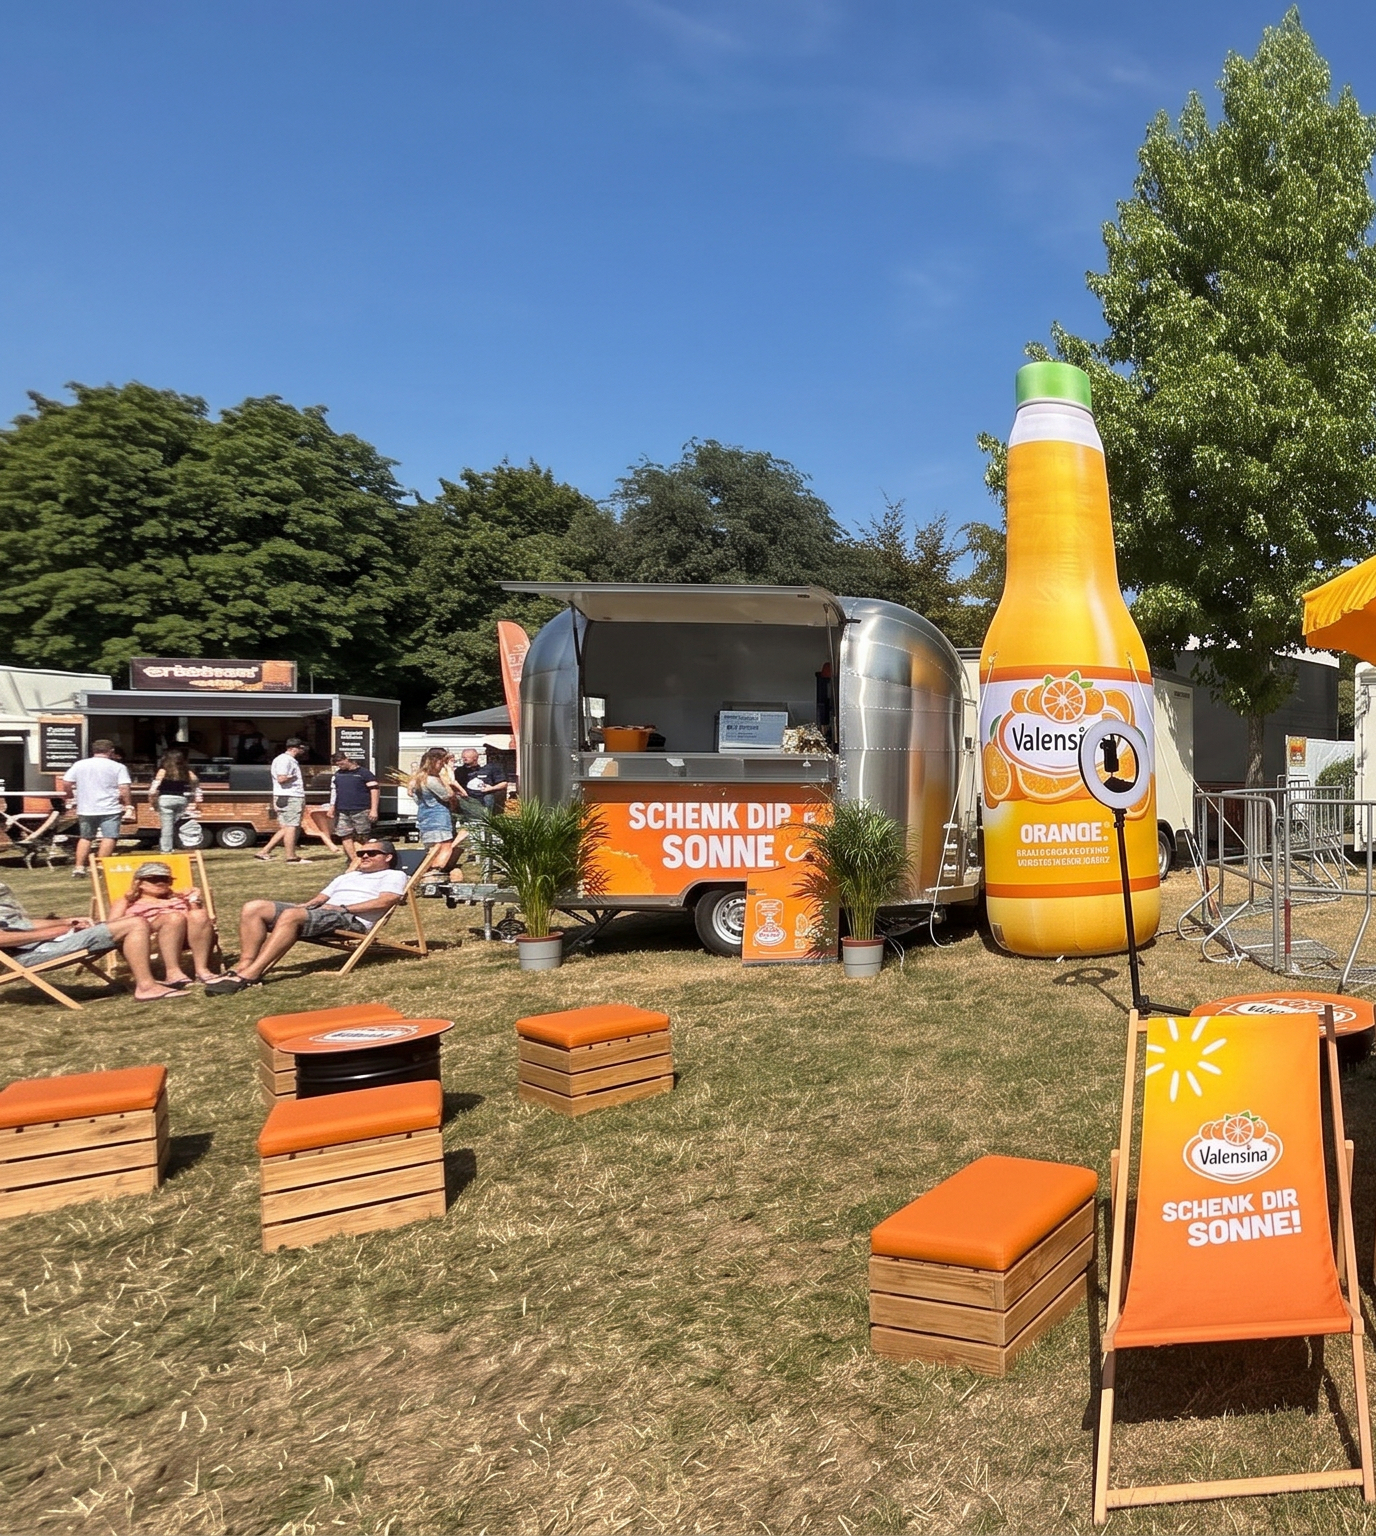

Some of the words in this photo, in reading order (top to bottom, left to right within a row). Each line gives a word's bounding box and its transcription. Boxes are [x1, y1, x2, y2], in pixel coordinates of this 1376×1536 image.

[1012, 722, 1086, 752] Valensi
[628, 801, 740, 831] SCHENK
[1199, 1144, 1269, 1166] Valensina
[1161, 1193, 1256, 1223] SCHENK
[1261, 1187, 1299, 1211] DIR
[1186, 1208, 1303, 1248] SONNE!
